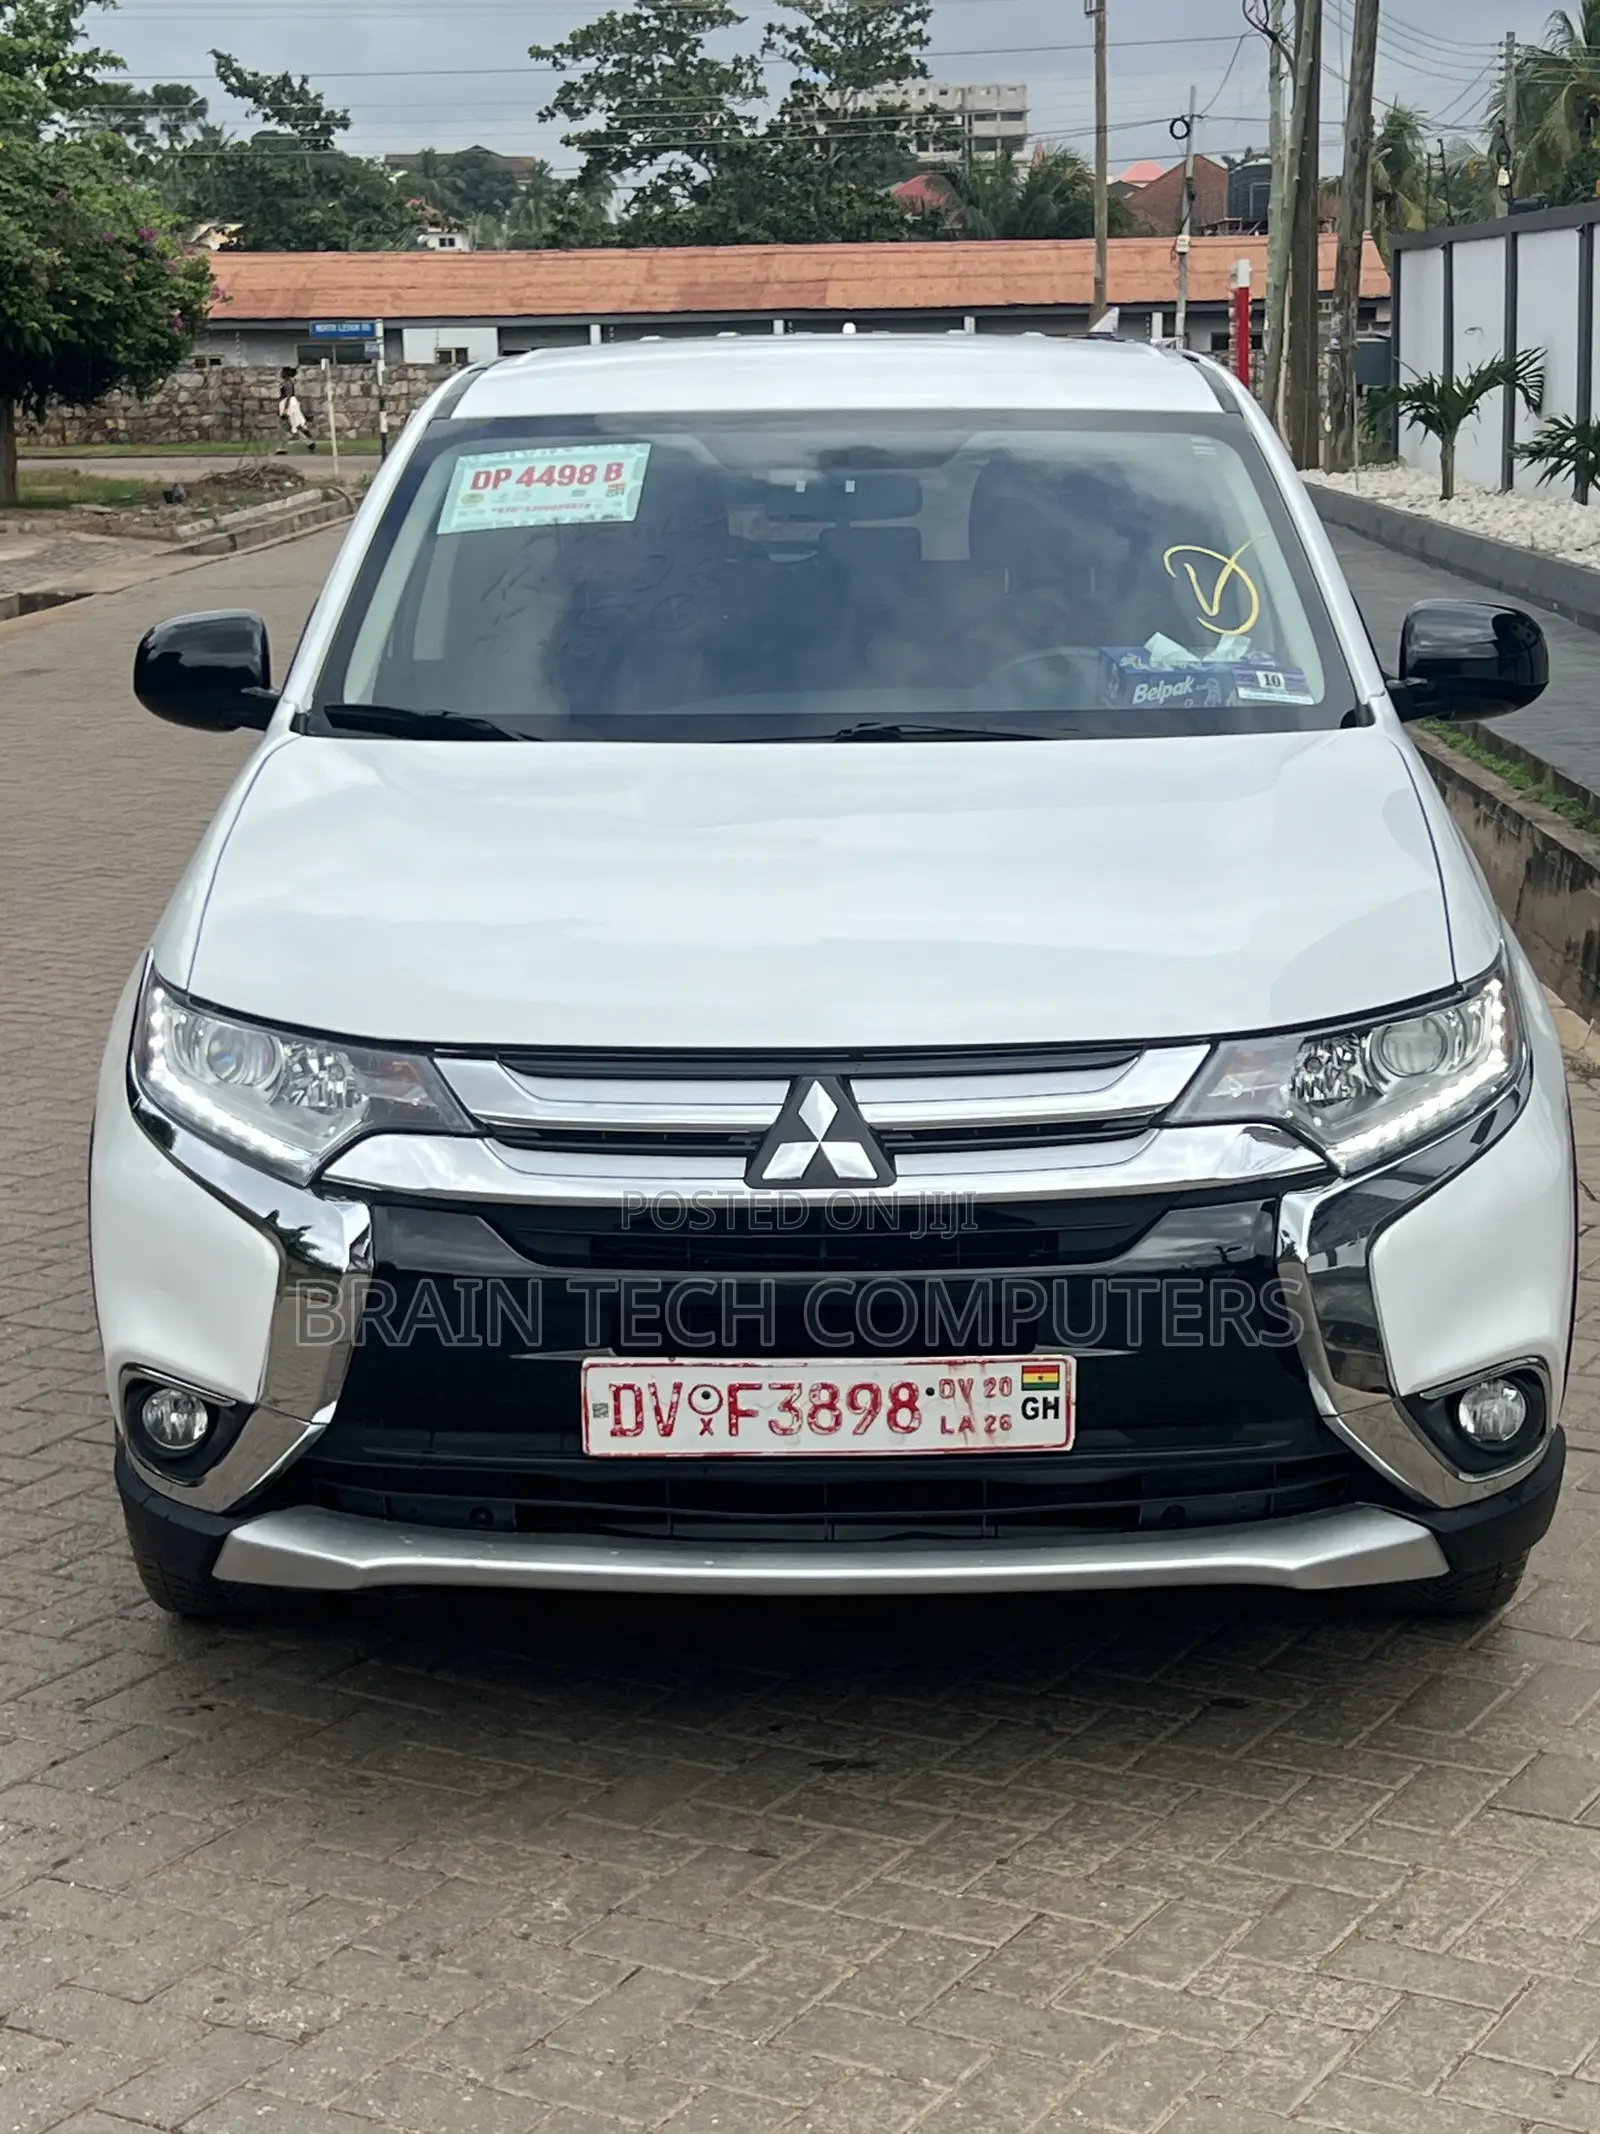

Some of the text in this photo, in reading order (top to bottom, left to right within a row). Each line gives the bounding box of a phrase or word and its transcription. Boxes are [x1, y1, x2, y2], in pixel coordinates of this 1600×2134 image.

[470, 462, 624, 491] DP 4498 B
[1132, 674, 1195, 705] Belpak
[1263, 673, 1281, 688] 10
[983, 1376, 1012, 1398] 20
[609, 1380, 922, 1437] DV F3898
[1021, 1396, 1060, 1420] GH
[940, 1415, 975, 1435] LA
